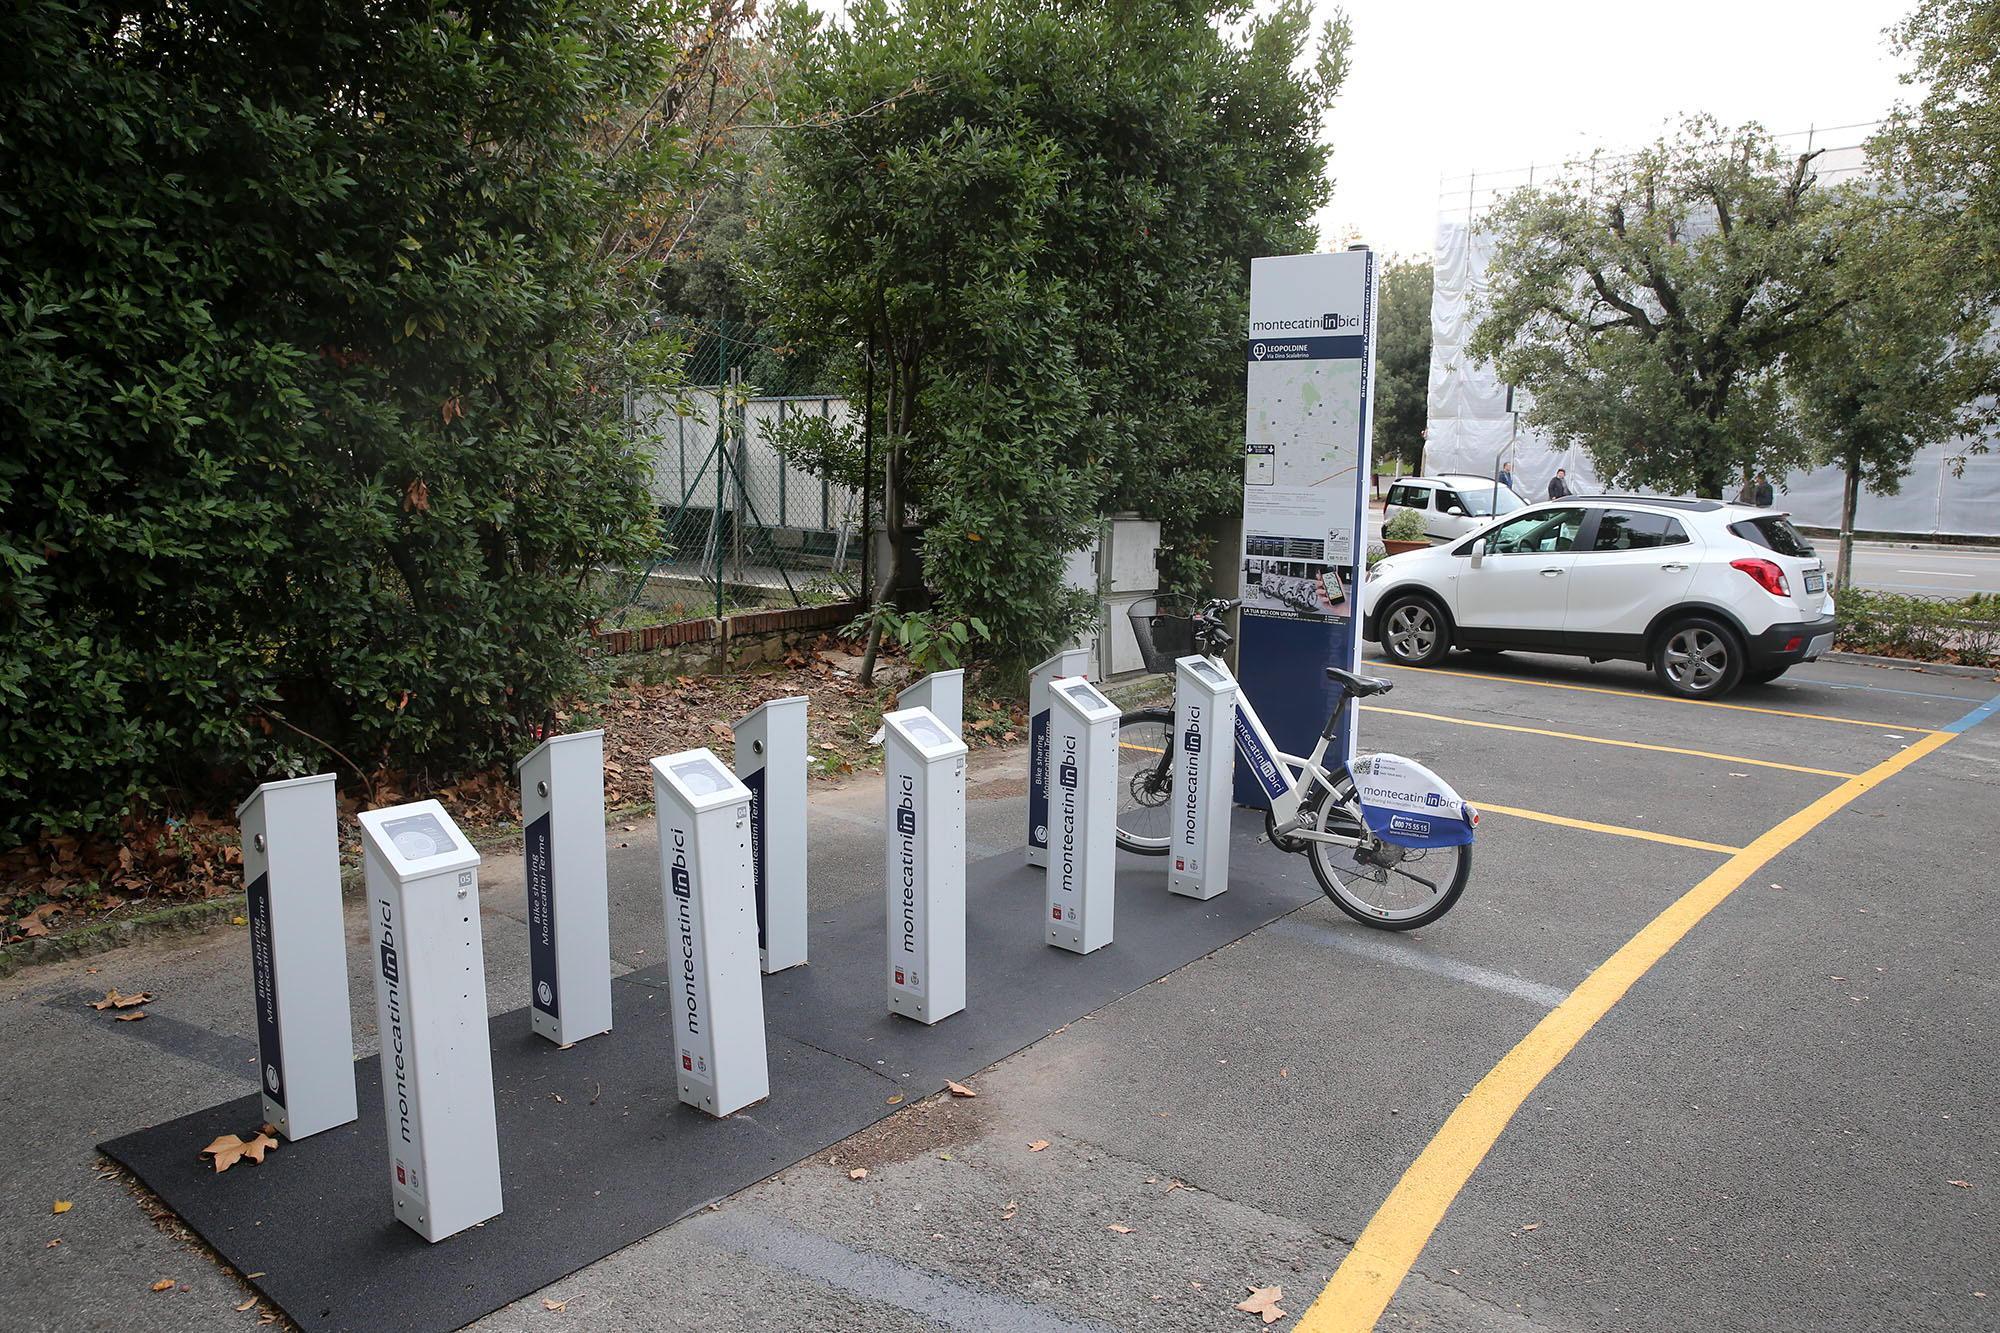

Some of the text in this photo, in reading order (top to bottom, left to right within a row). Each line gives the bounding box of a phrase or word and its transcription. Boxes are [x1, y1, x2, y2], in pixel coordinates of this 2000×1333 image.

[1267, 345, 1308, 353] LEOPOLDINE
[1036, 734, 1045, 765] sharing
[751, 788, 759, 820] Terme
[1394, 820, 1404, 828] 800
[1412, 823, 1419, 831] 55
[1420, 824, 1427, 832] 15
[459, 875, 471, 885] 05
[532, 853, 540, 897] sharing
[539, 875, 549, 945] Montecatini
[254, 916, 263, 968] sharing
[258, 896, 273, 1024] Montecatini Terme
